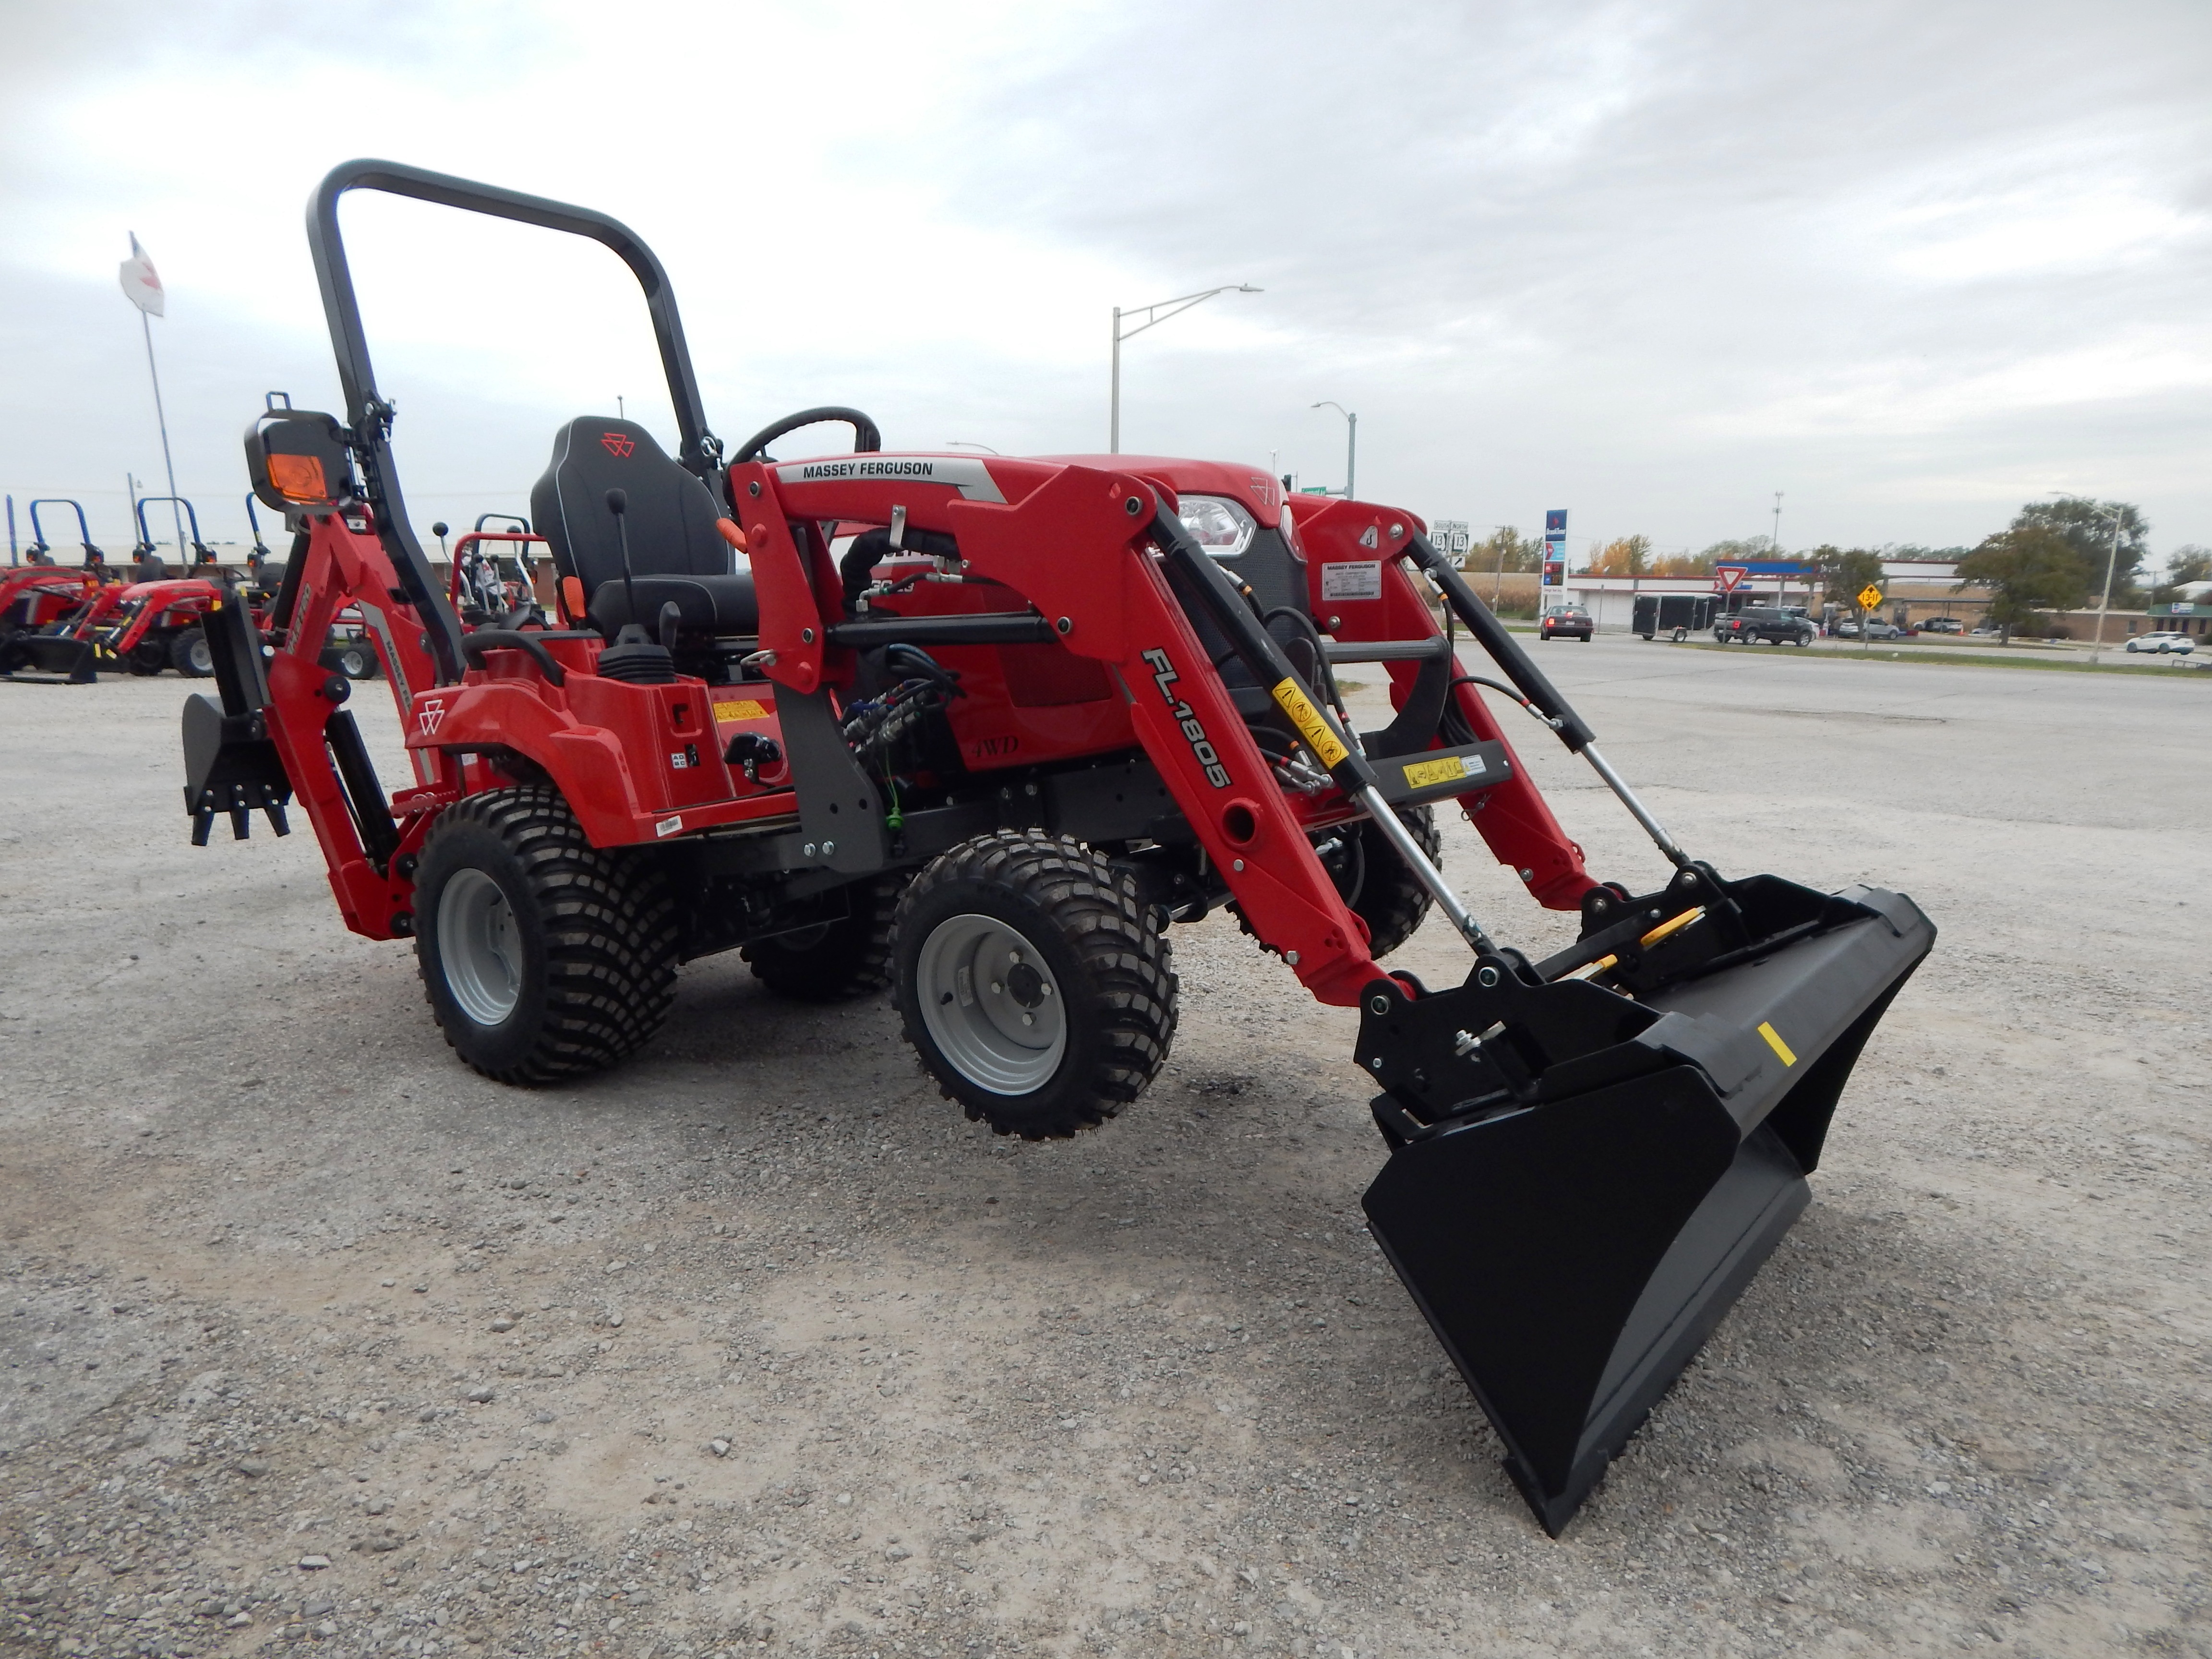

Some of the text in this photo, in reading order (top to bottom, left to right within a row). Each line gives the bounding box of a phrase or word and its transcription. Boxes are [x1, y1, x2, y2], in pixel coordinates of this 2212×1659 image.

[803, 462, 933, 478] MASSEY FERGUSON
[1435, 535, 1443, 546] 13
[1456, 536, 1464, 547] 13
[386, 640, 405, 685] MASSEY
[971, 735, 1019, 757] 4WD
